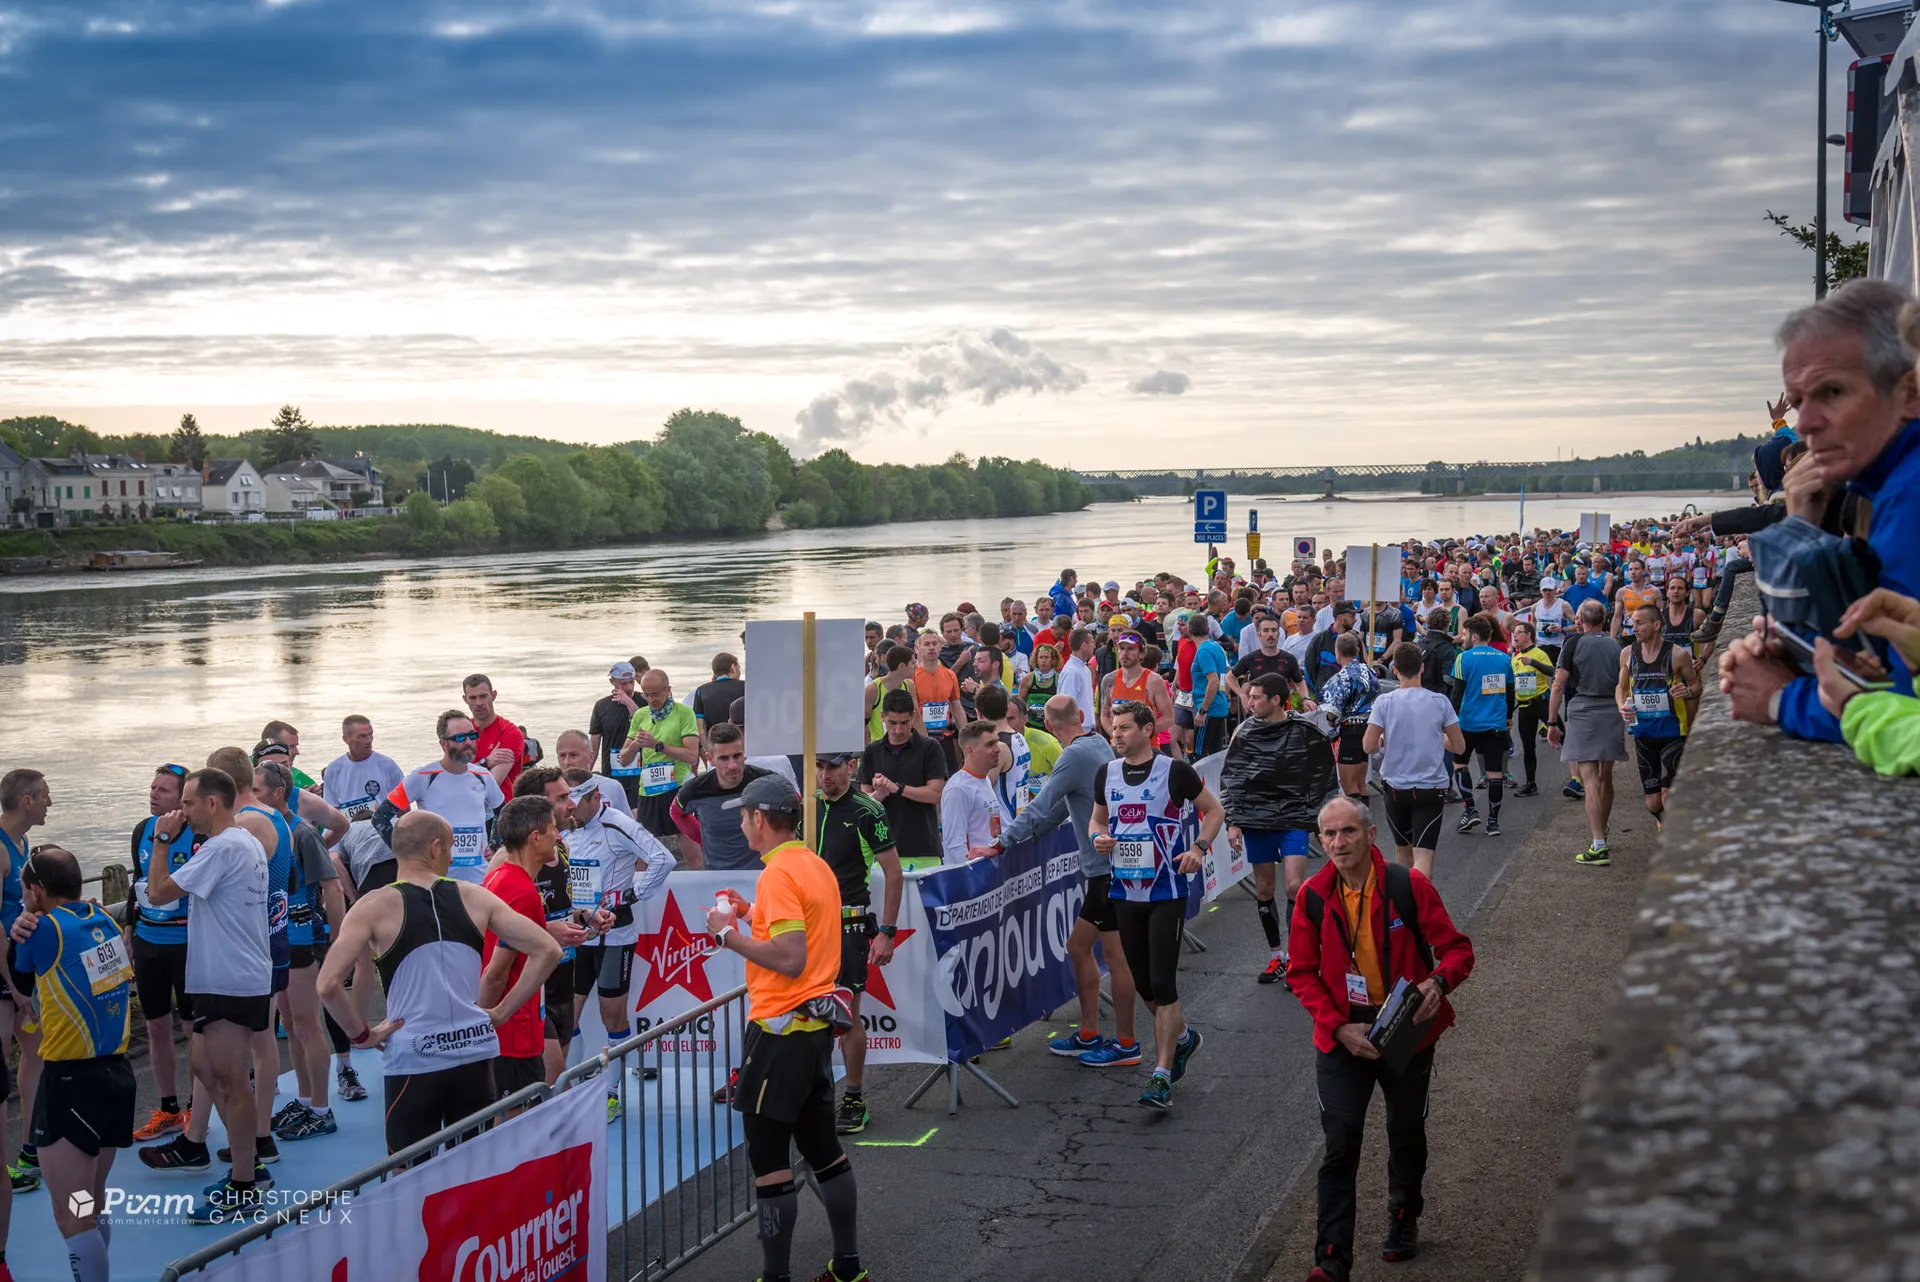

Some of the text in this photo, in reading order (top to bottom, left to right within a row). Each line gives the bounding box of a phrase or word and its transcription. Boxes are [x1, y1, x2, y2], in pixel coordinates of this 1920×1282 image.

[1203, 496, 1218, 516] P
[1640, 695, 1660, 705] 5660
[929, 706, 945, 716] 5082
[650, 766, 665, 779] 5911
[453, 834, 477, 848] 3929
[1119, 842, 1142, 857] 5598
[570, 867, 589, 882] 5077
[96, 941, 117, 963] 6131
[651, 925, 714, 984] Virgin
[436, 1022, 495, 1045] RUNNING
[438, 1040, 472, 1053] SHOP
[451, 1189, 583, 1282] Courrier
